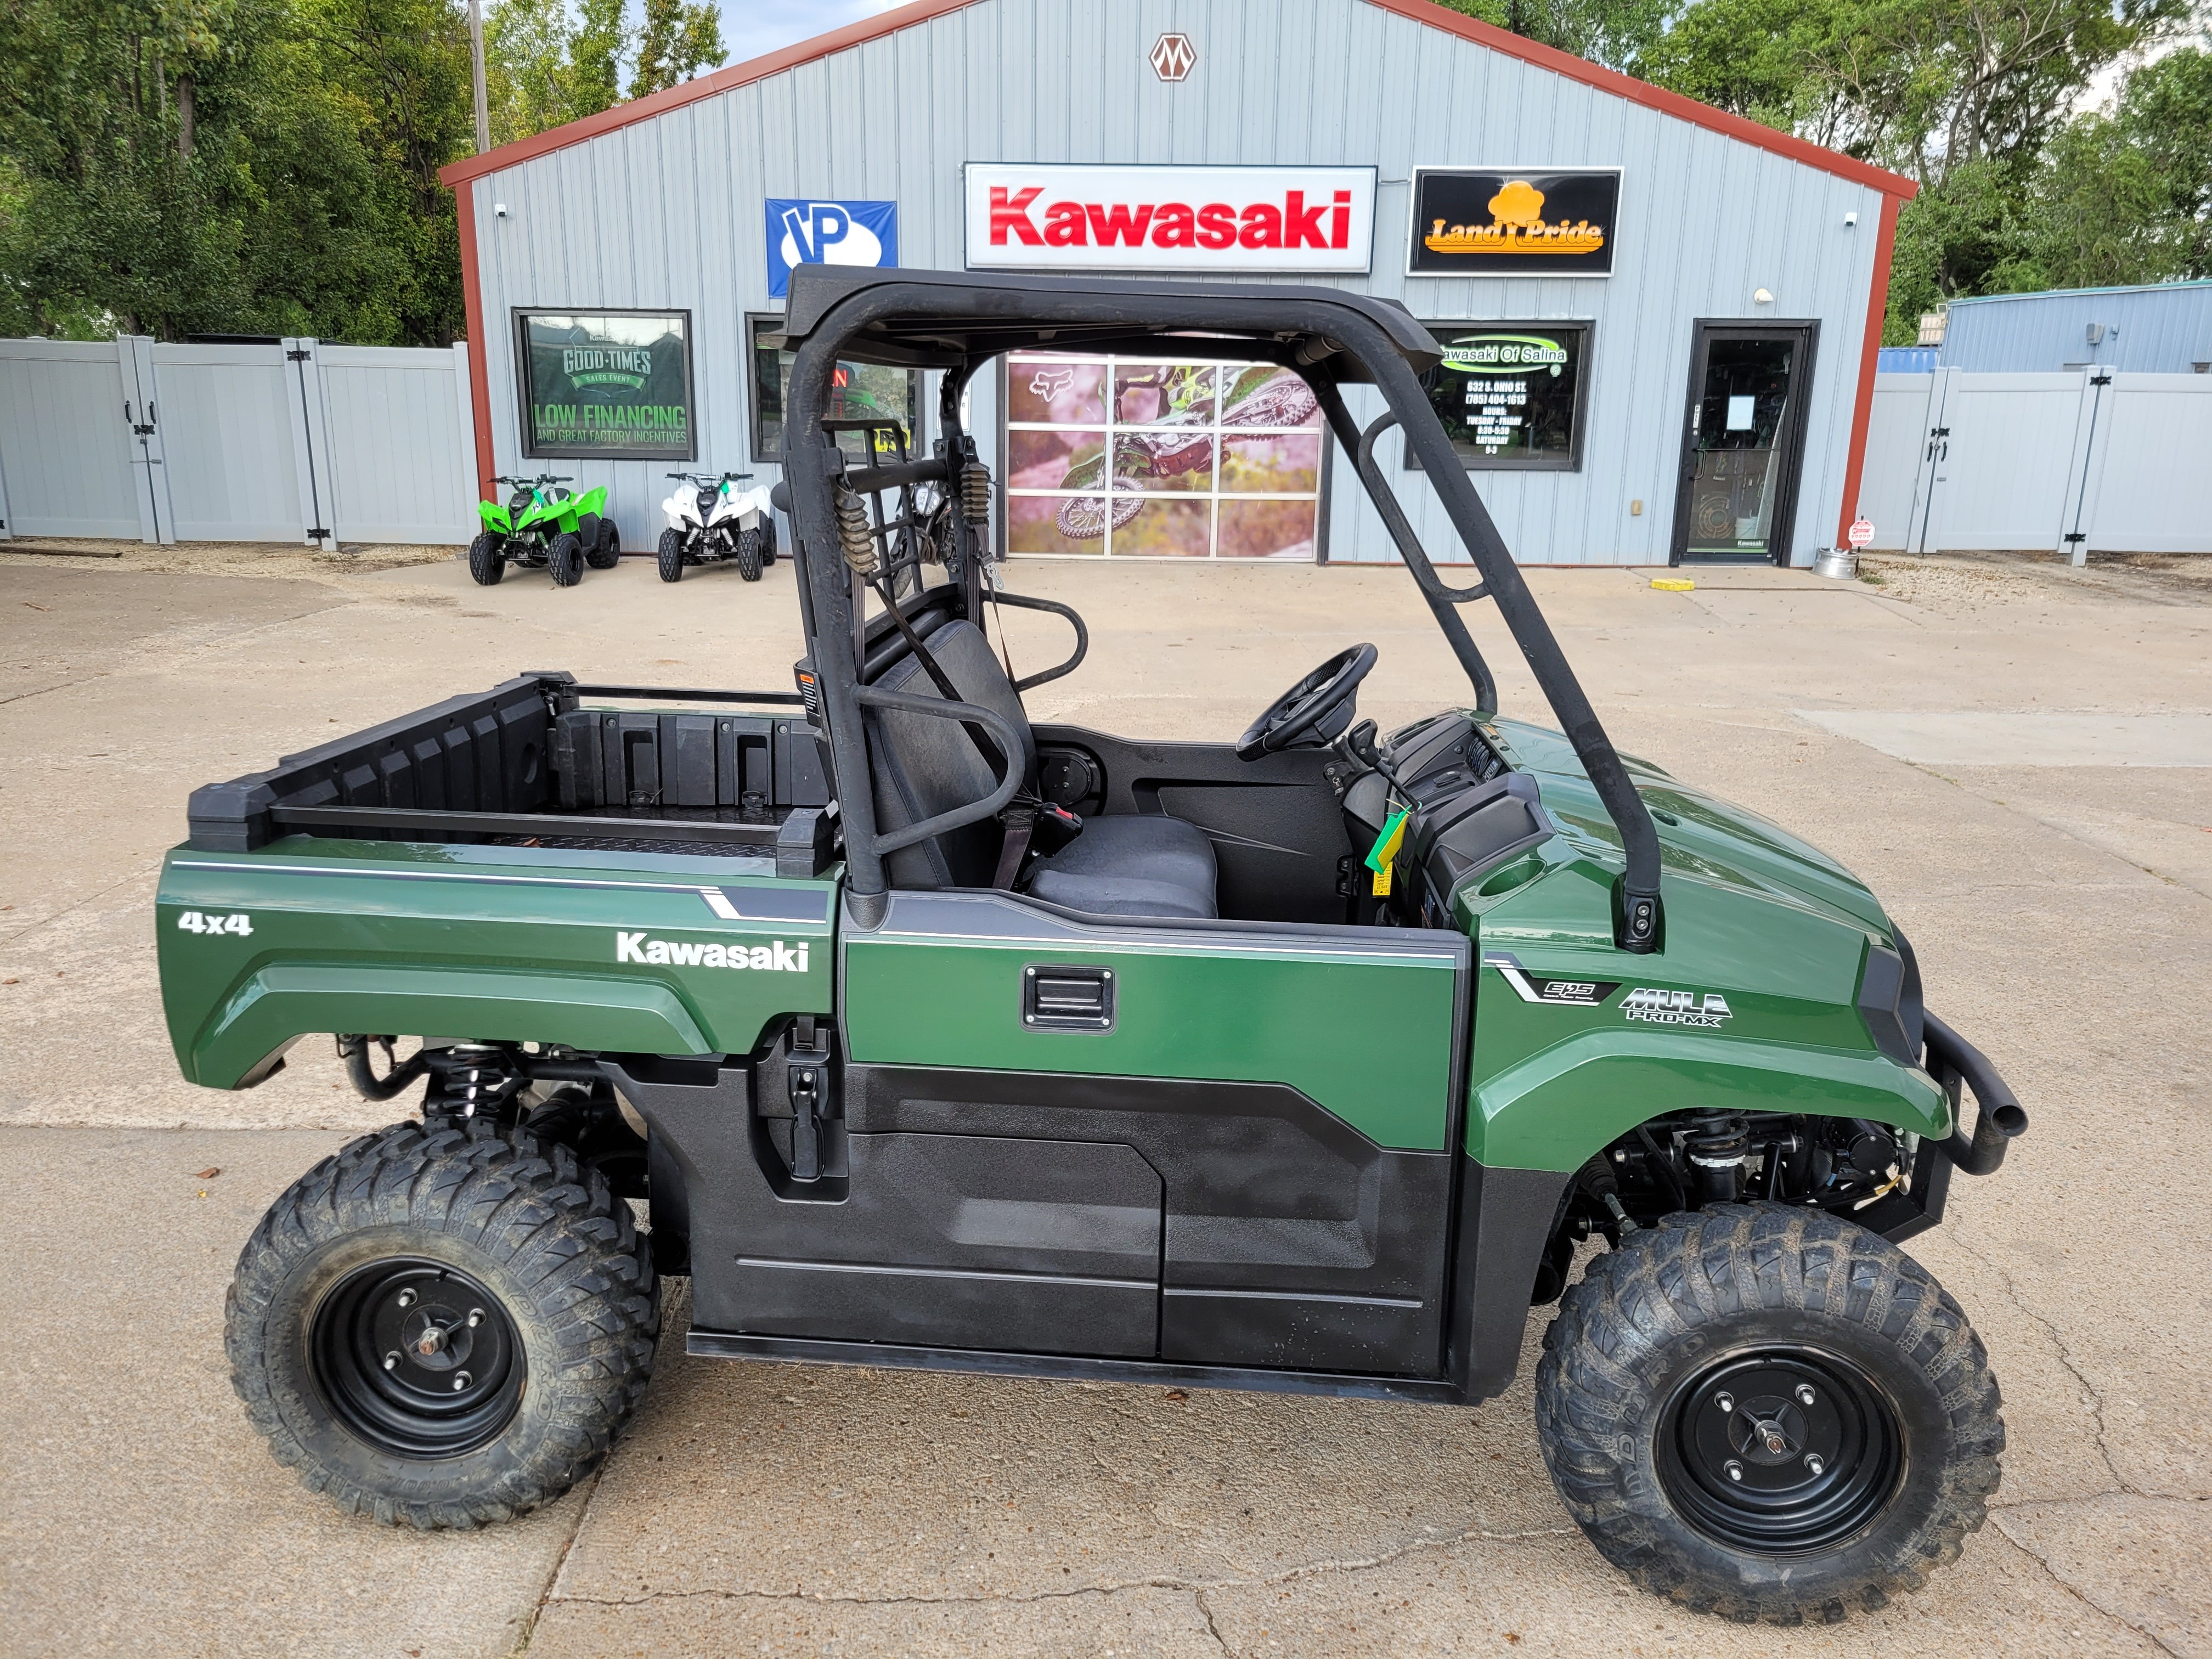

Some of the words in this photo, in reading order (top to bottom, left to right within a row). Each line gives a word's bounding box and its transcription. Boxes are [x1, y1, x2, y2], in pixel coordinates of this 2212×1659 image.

[990, 186, 1351, 250] Kawasaki
[782, 203, 851, 264] VP
[1429, 219, 1503, 244] Land
[1522, 219, 1601, 244] Pride
[563, 349, 603, 374] GOOD
[608, 351, 651, 374] TIMES
[1441, 348, 1497, 361] awasaki
[1502, 348, 1519, 361] Of
[1523, 348, 1565, 362] Salina
[586, 374, 607, 383] SALES
[609, 375, 630, 383] EVENT
[1467, 381, 1483, 392] 632
[1485, 381, 1493, 392] S.
[1494, 382, 1514, 392] OHIO
[1515, 382, 1527, 392] ST.
[1465, 393, 1487, 404] (785)
[1488, 394, 1526, 405] 404-1613
[534, 404, 576, 429] LOW
[584, 405, 686, 430] FINANCING
[1482, 407, 1507, 415] HOURS:
[1466, 416, 1494, 425] TUESDAY
[1499, 416, 1522, 425] FRIDAY
[537, 430, 556, 442] AND
[558, 430, 586, 442] GREAT
[589, 430, 630, 443] FACTORY
[634, 431, 687, 443] INCENTIVES
[1476, 435, 1509, 444] SATURDAY
[1485, 445, 1498, 454] 9-3
[178, 911, 254, 936] 4x4
[616, 932, 810, 973] Kawasaki
[1618, 988, 1733, 1018] MULE
[1626, 1009, 1722, 1028] PRO-MX
